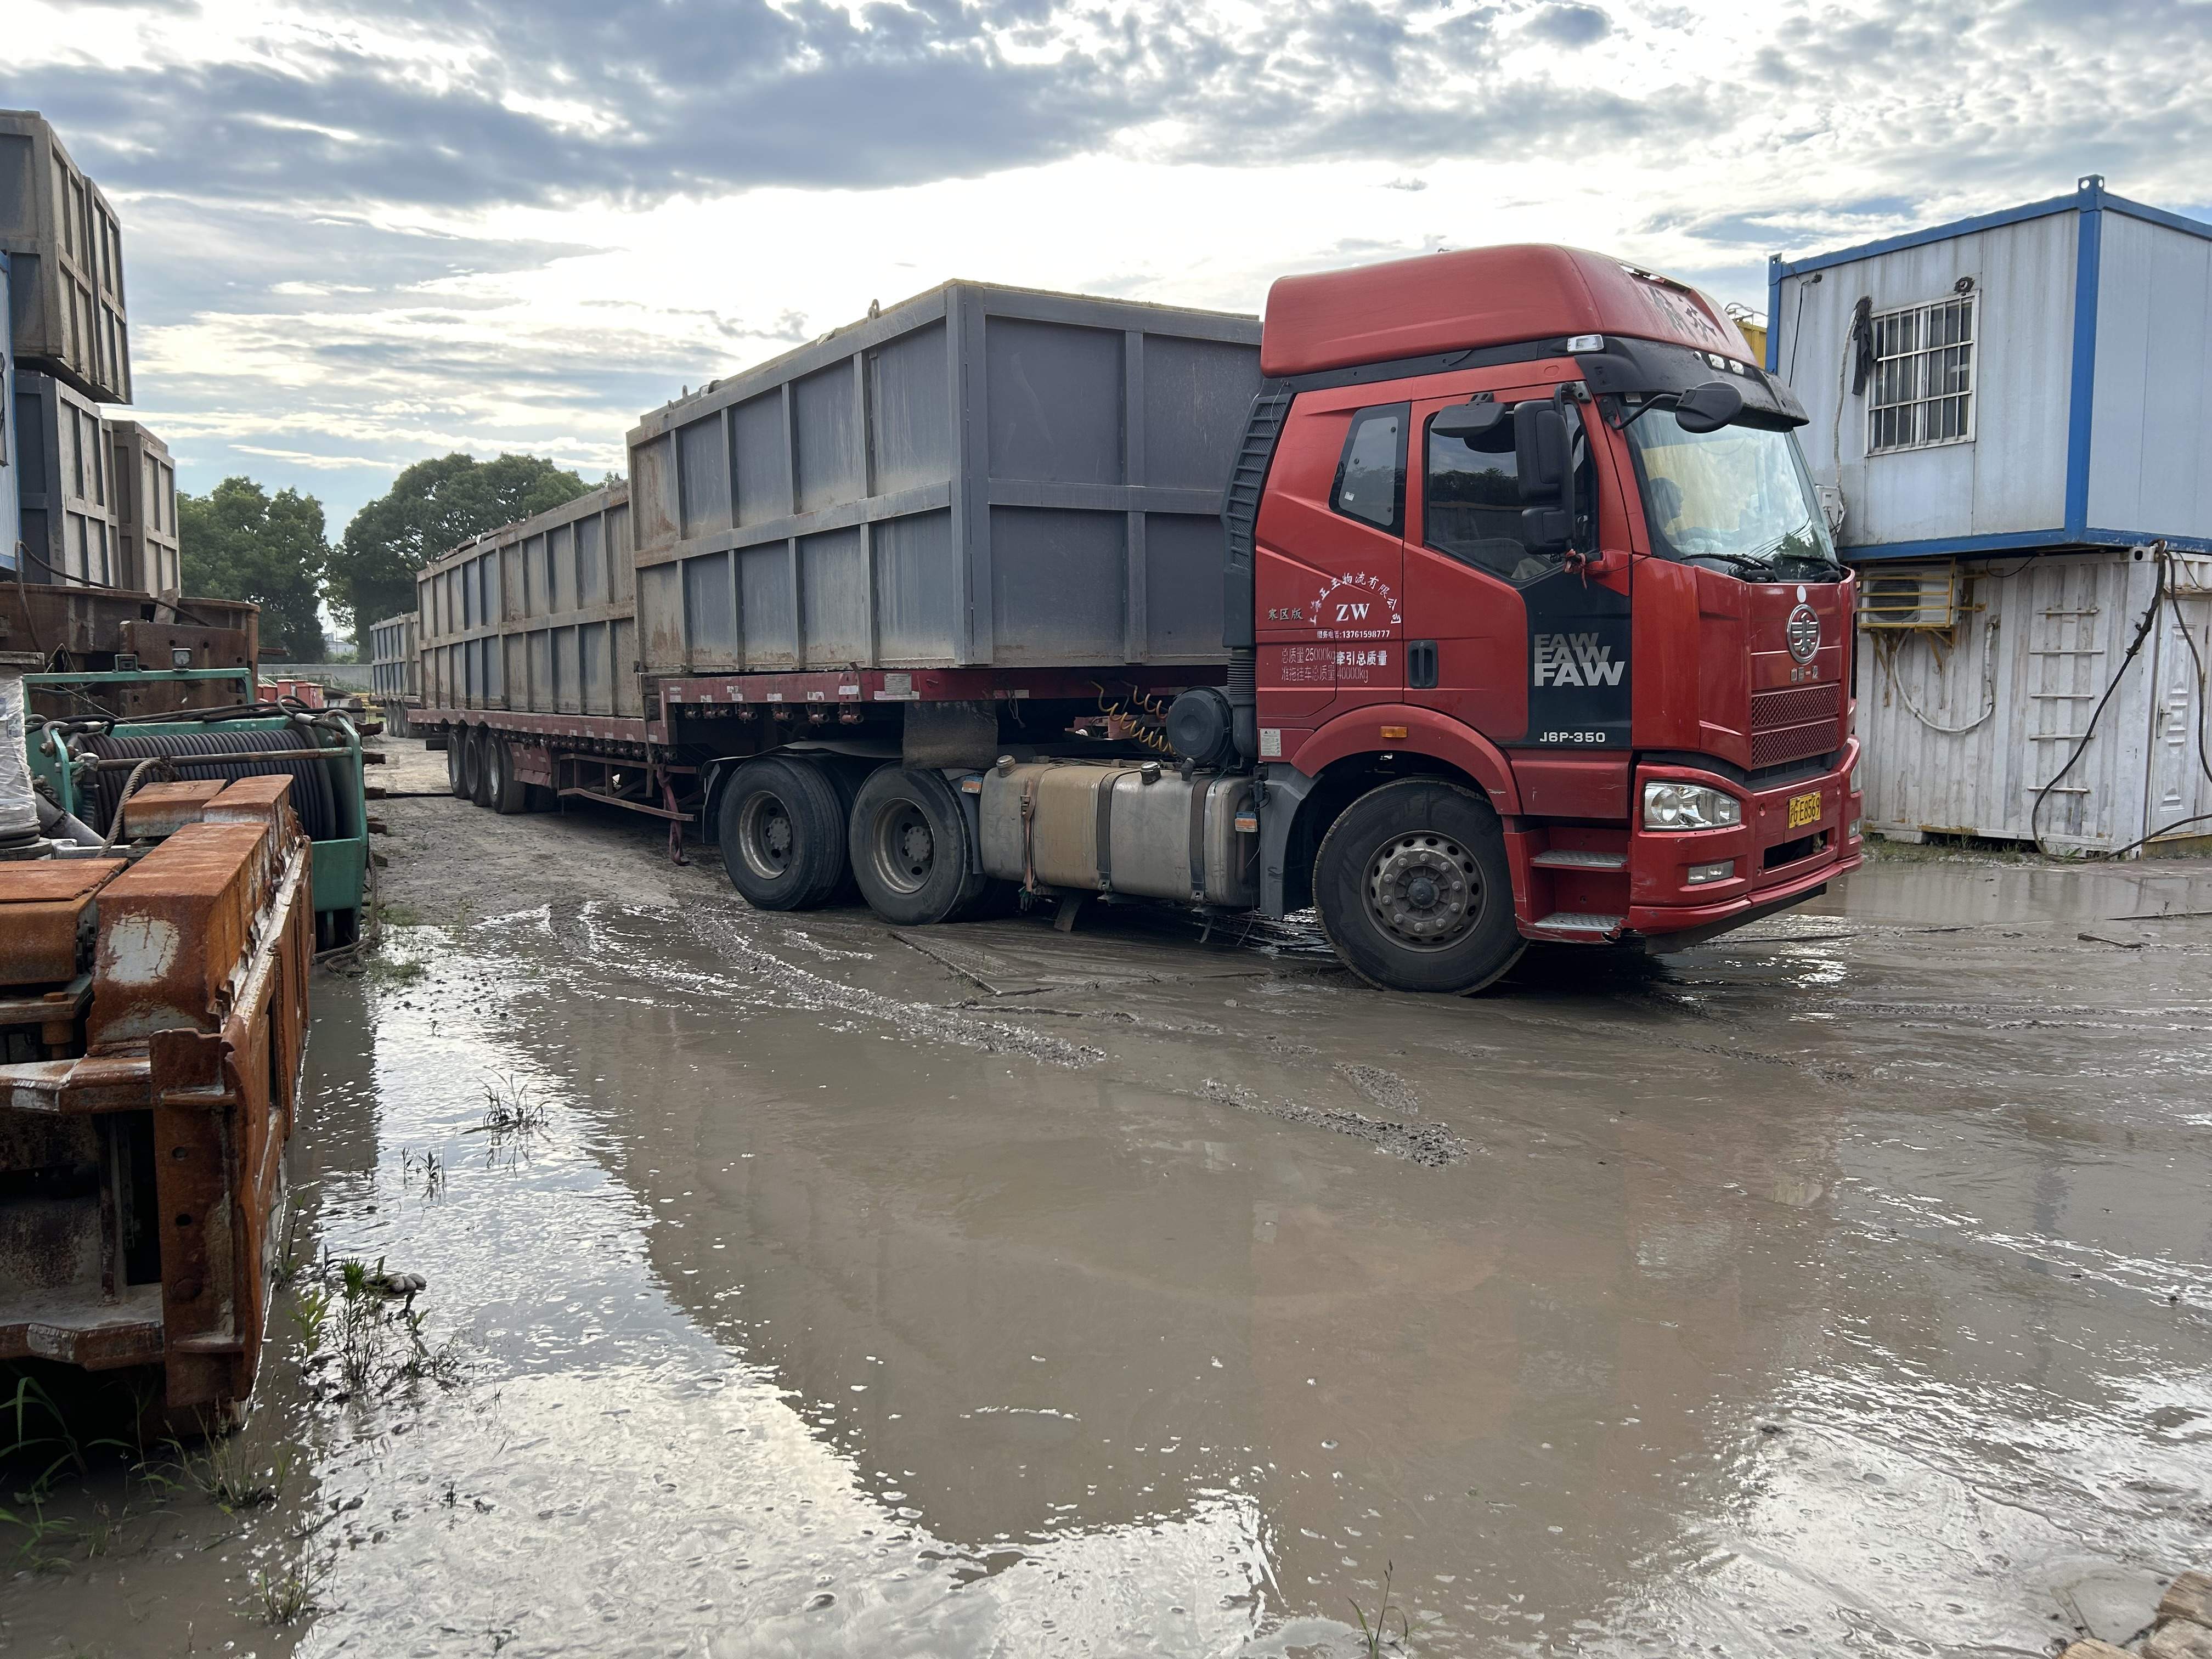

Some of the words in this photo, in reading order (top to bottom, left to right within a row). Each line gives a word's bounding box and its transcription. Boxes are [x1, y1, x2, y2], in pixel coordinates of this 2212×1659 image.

[1268, 607, 1304, 620] 寒区版
[1336, 603, 1370, 622] ZW
[1336, 650, 1387, 666] 牵引总质量
[1534, 646, 1611, 667] FAW
[1534, 661, 1625, 686] FAW
[1539, 732, 1606, 743] J6P-350
